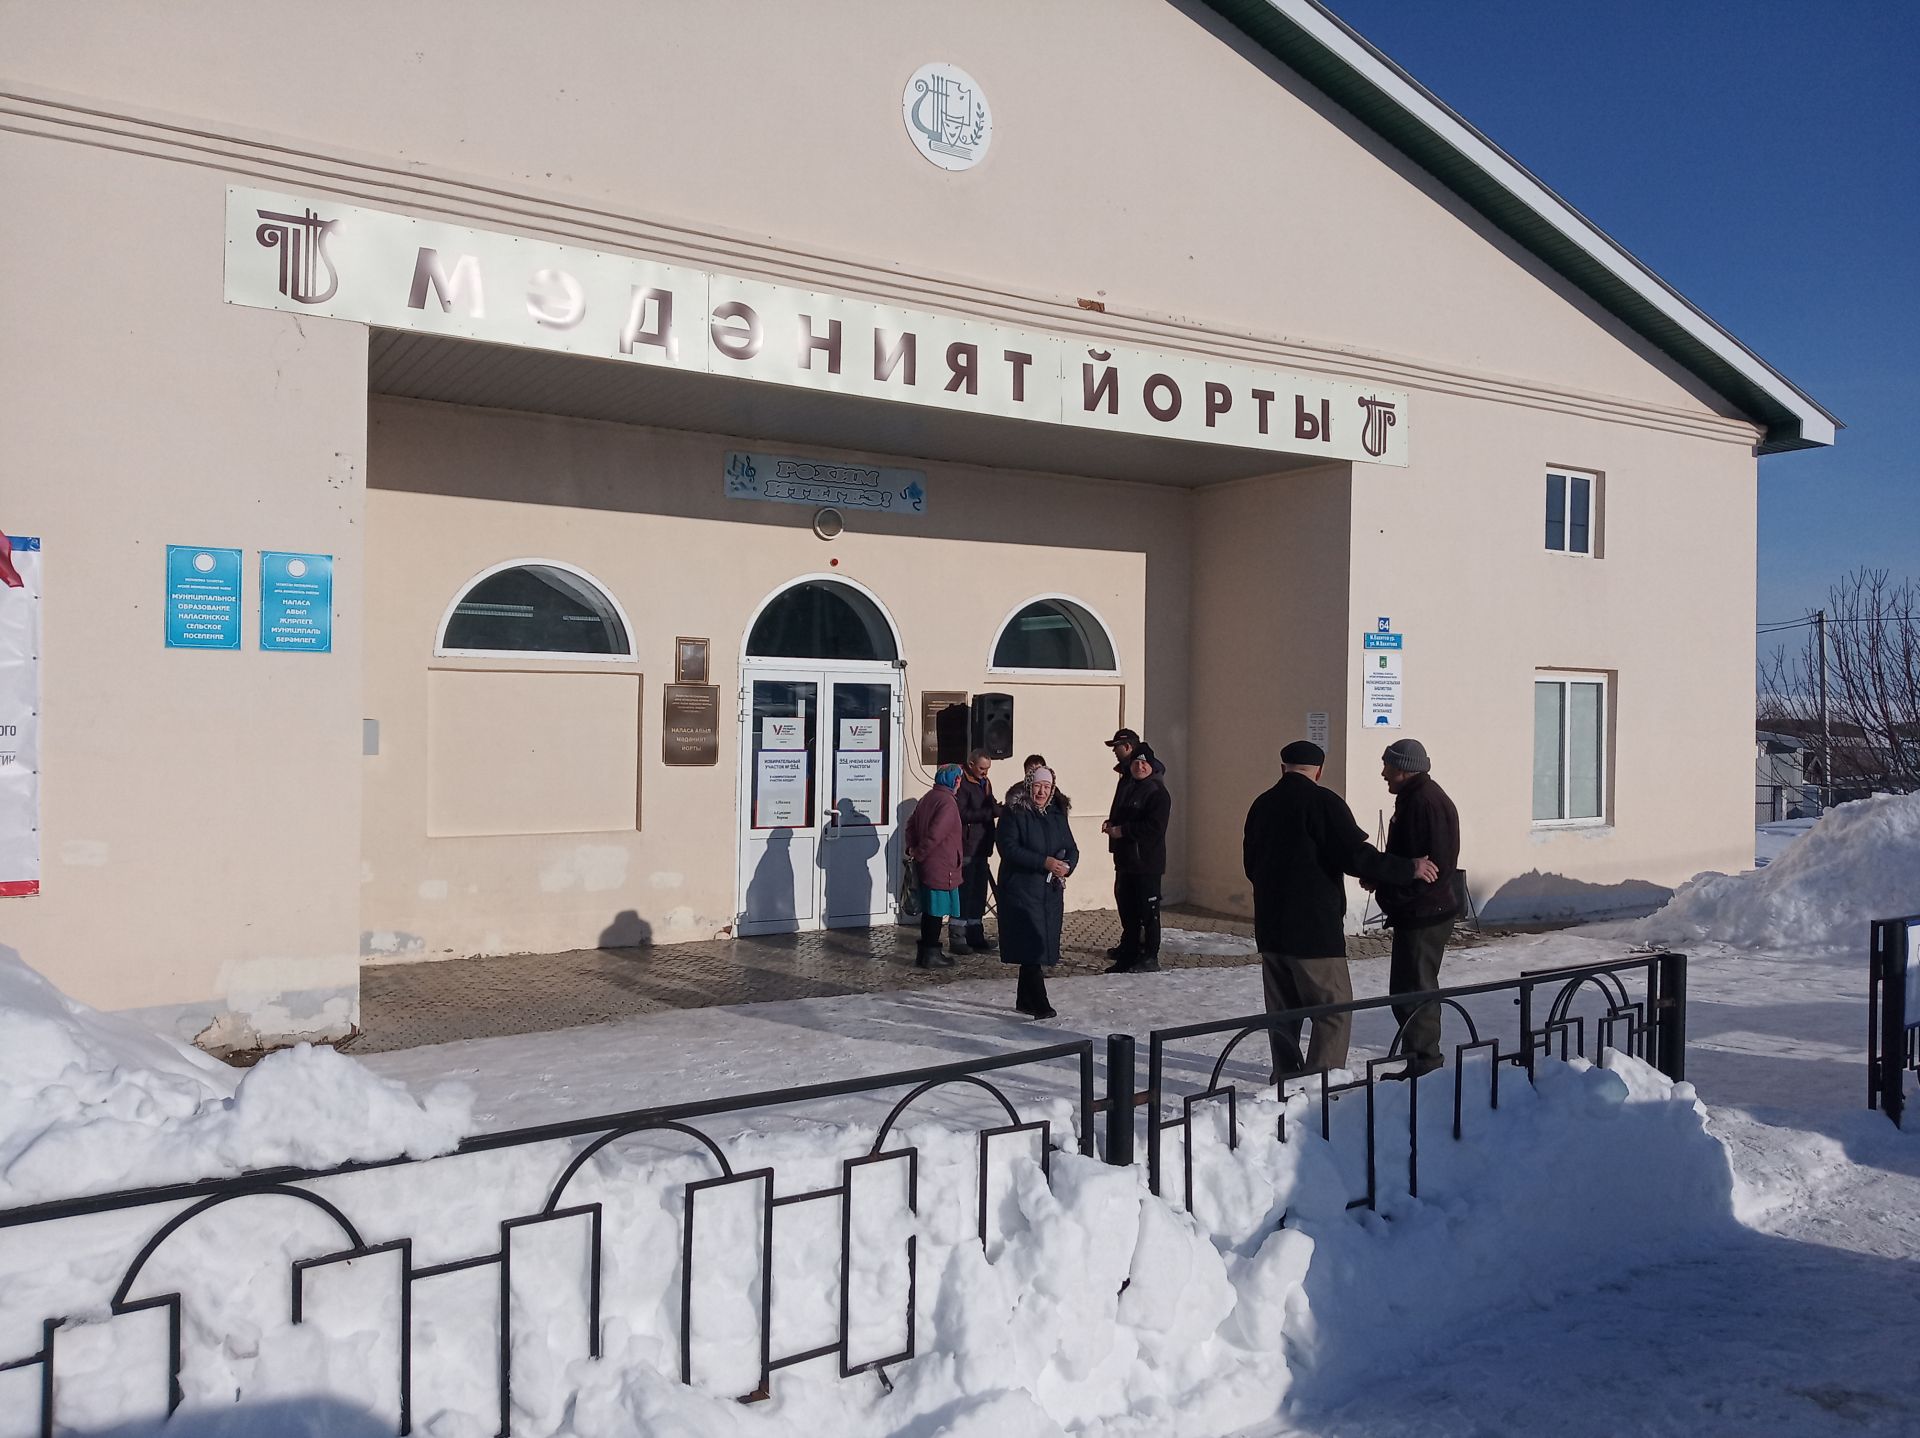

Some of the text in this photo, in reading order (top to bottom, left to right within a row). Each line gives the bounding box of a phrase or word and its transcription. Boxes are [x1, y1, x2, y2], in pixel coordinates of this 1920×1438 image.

[1082, 349, 1331, 442] ЙОРТЫ
[171, 594, 236, 602] МУНИЦИПАЛЬНОЕ
[178, 603, 231, 611] ОБРАЗОВАНИЕ
[178, 613, 230, 621] НАЛАСИНСКОЕ
[1380, 620, 1389, 630] 64
[271, 627, 321, 635] МУНИЦИПАЛЬ
[183, 632, 224, 640] ПОСЕЛЕНИЕ
